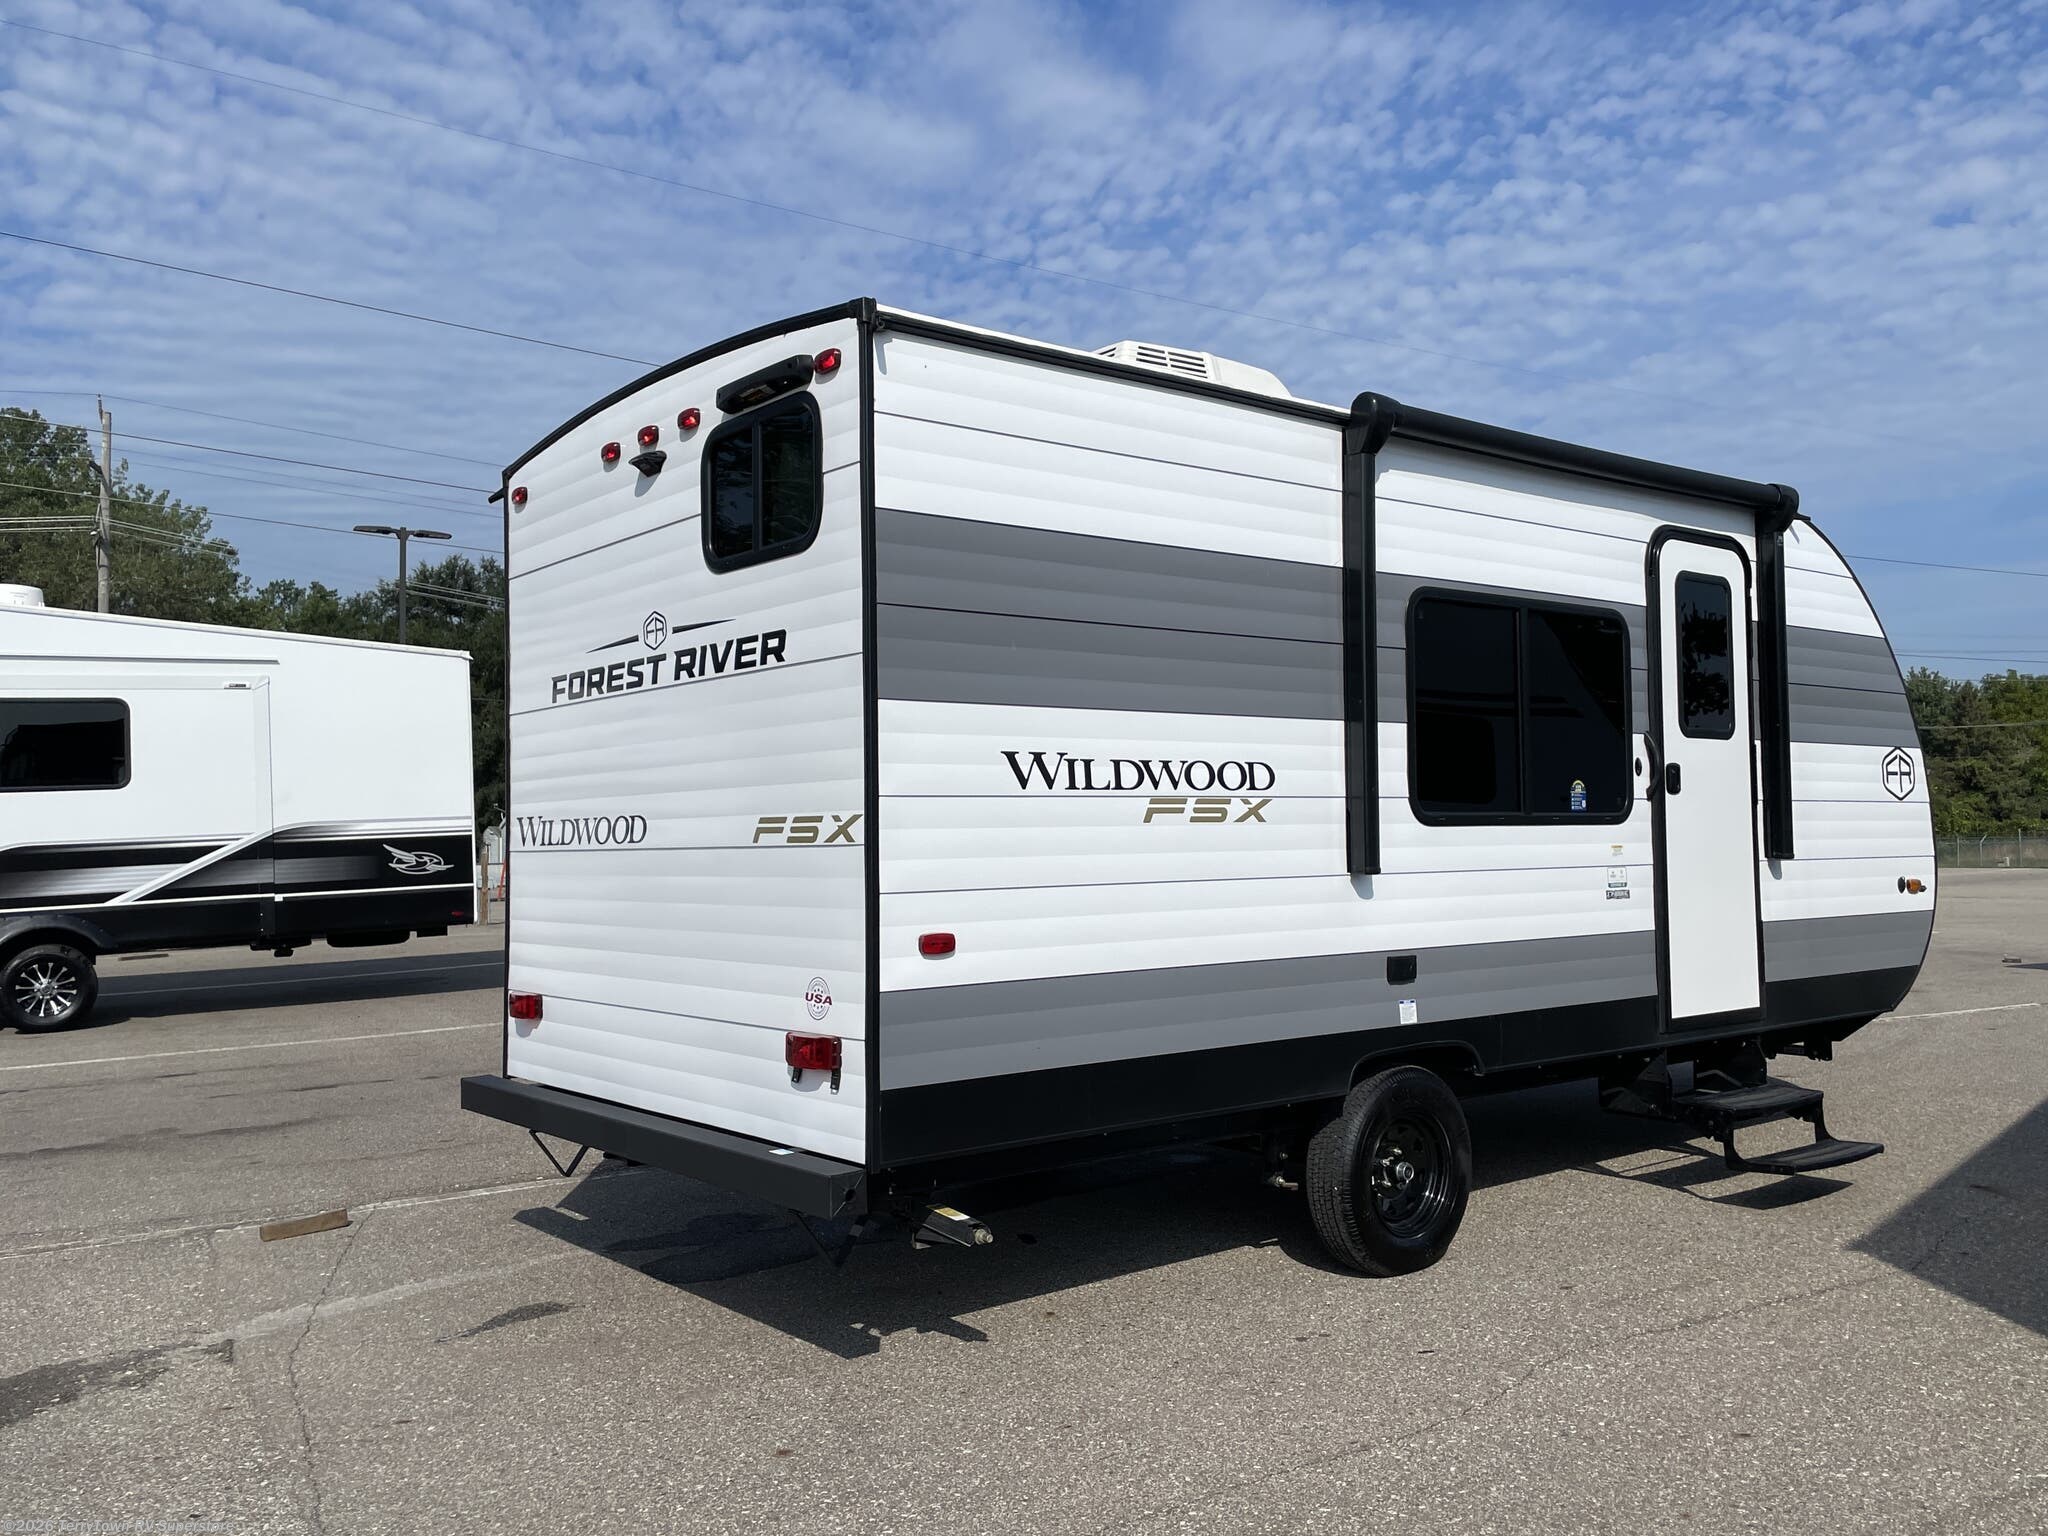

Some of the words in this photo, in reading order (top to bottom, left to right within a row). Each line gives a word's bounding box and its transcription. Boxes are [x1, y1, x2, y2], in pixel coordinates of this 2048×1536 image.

[551, 653, 667, 704] FOREST
[673, 628, 787, 682] RIVER
[1000, 750, 1276, 791] WILDWOOD
[1142, 798, 1273, 824] FSX
[516, 814, 648, 847] WILDWOOD
[752, 813, 864, 844] FSX
[805, 992, 832, 1005] USA
